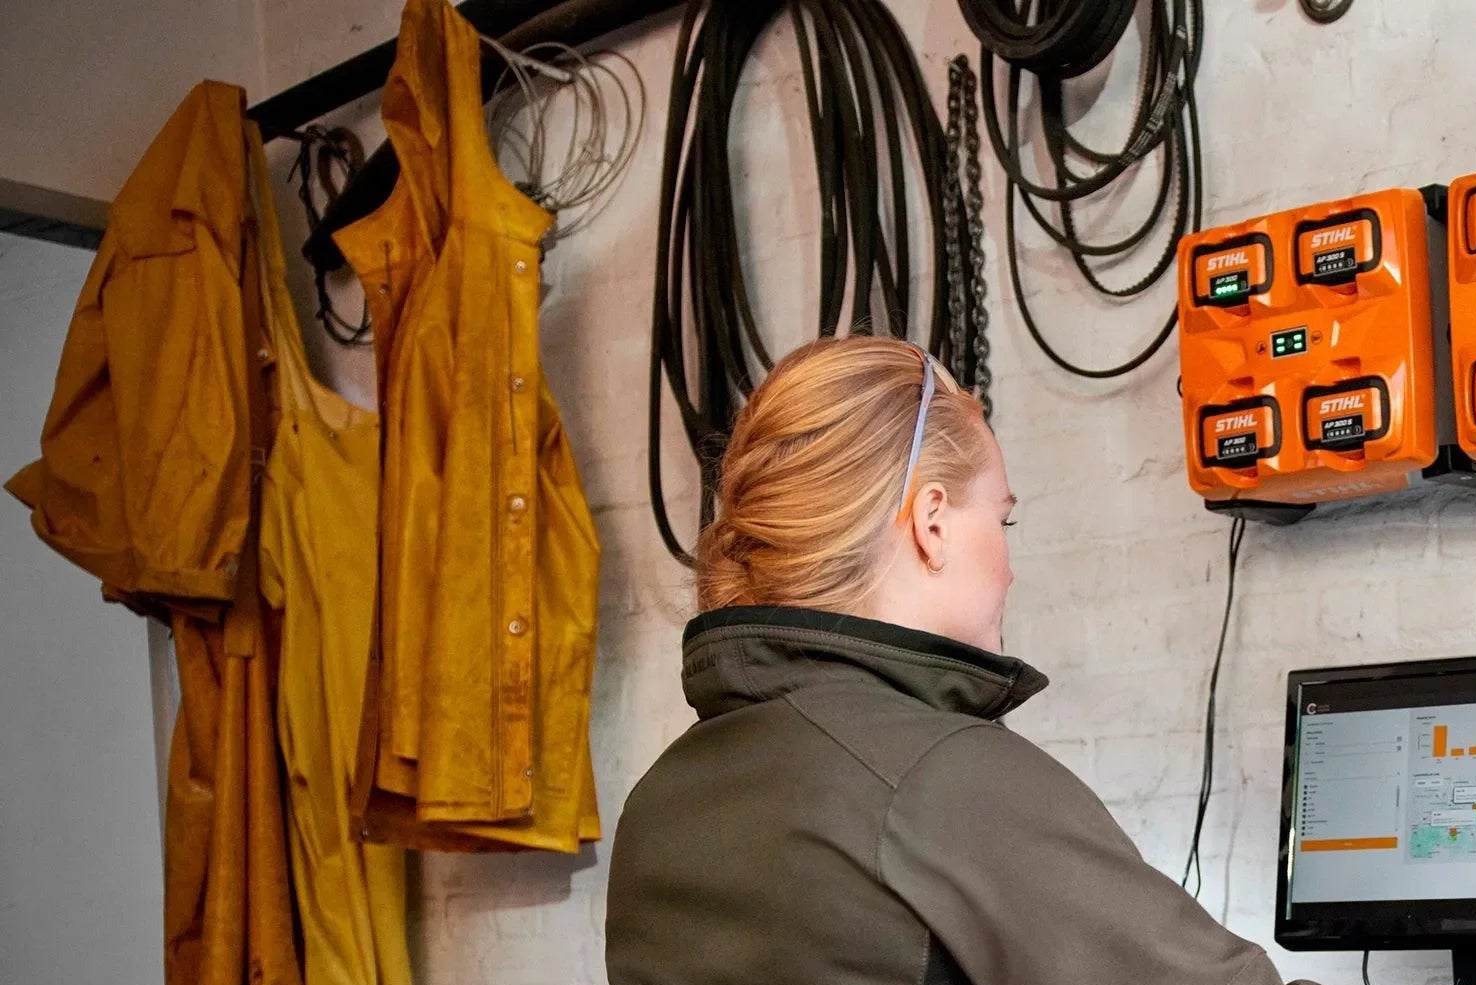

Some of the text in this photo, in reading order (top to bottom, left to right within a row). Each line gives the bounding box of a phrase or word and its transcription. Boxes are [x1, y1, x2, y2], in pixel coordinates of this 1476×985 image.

[1310, 226, 1355, 248] STIHL
[1207, 251, 1249, 271] STIHL
[1320, 395, 1364, 414] STIHL
[1215, 414, 1258, 432] STIHL
[1324, 421, 1334, 429] AP
